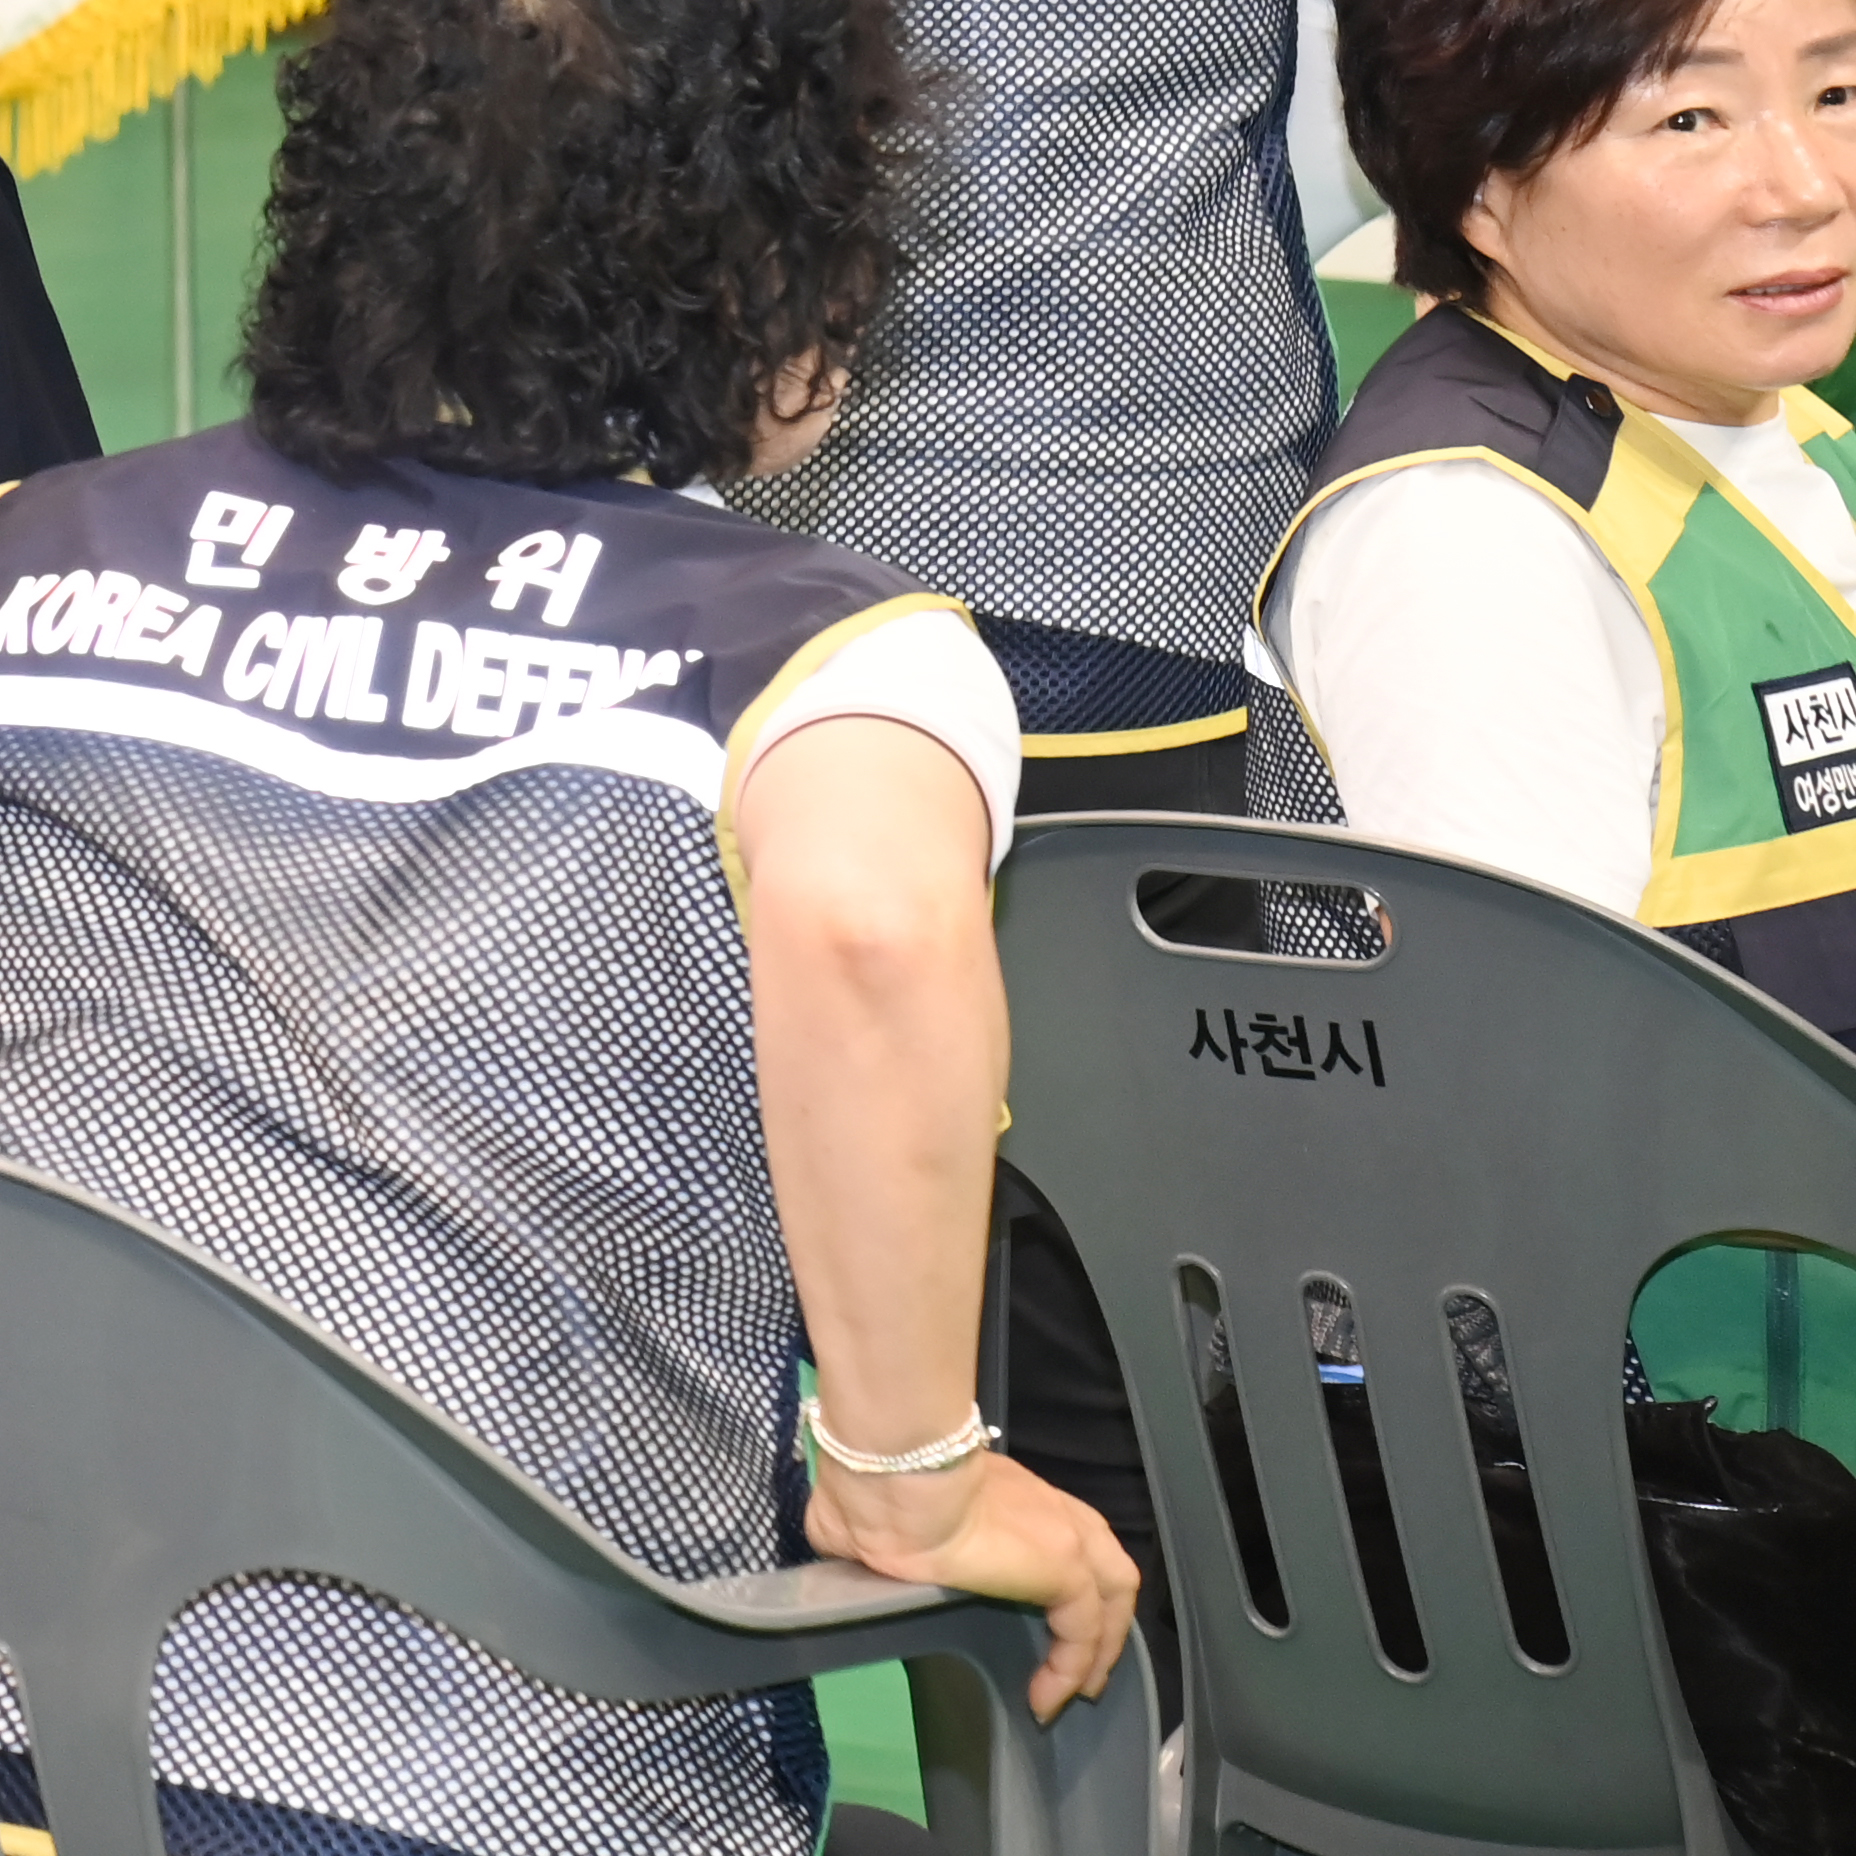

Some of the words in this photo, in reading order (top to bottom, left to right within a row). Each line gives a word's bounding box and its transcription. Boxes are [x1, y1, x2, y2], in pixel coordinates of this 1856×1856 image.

[222, 611, 389, 723] CIVIL
[401, 620, 704, 738] DEFEN
[1793, 762, 1856, 819] 여성민
[1188, 1008, 1386, 1088] 사천시
